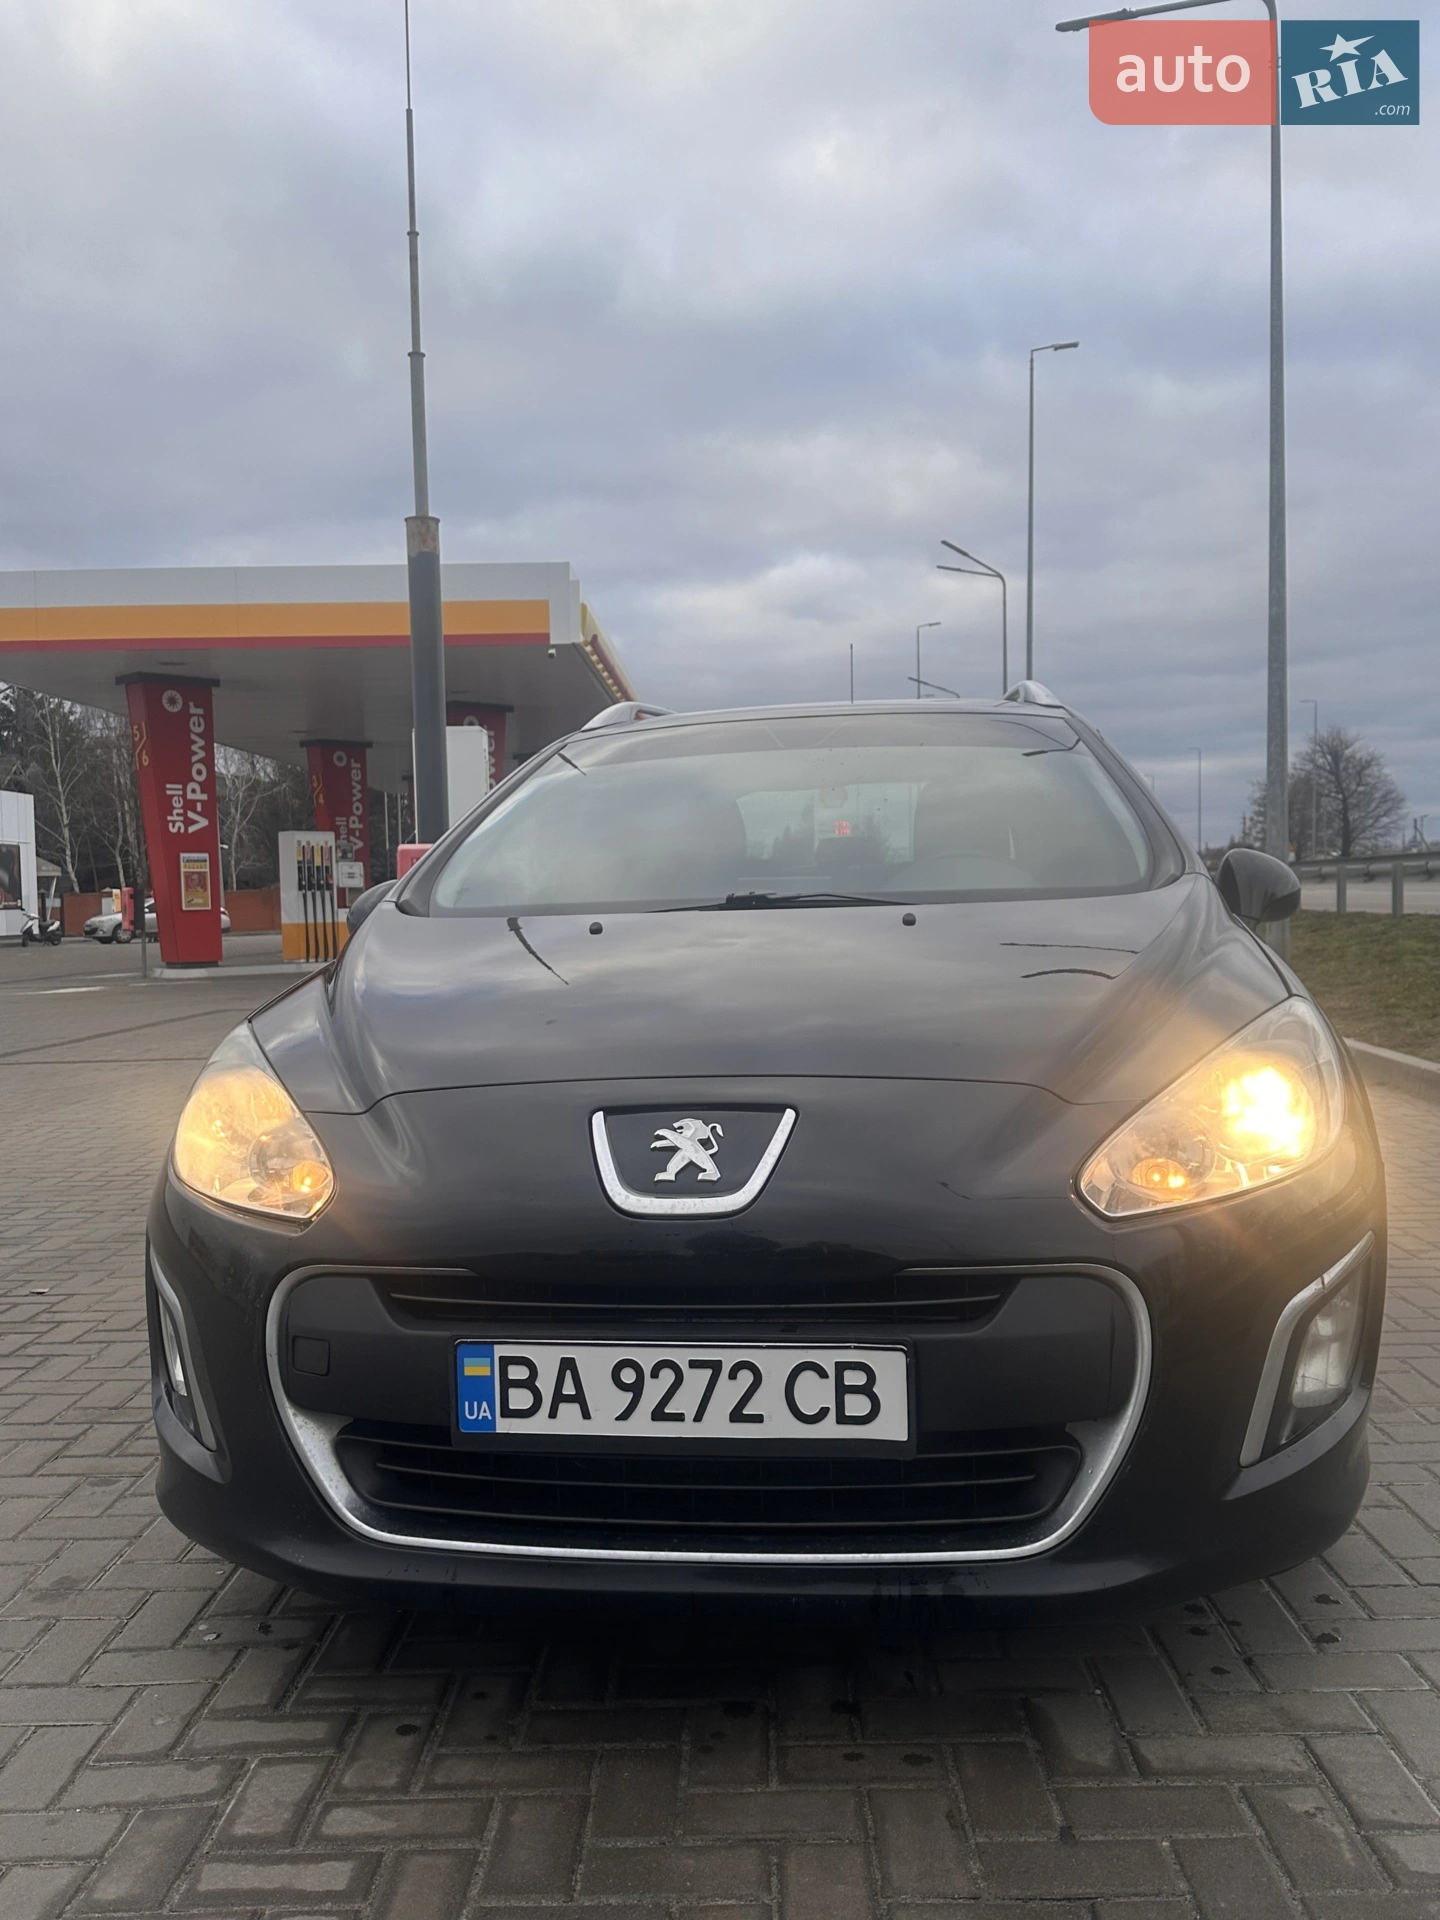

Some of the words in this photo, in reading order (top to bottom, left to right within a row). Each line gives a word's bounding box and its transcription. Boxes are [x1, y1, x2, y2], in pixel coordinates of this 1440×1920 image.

[133, 725, 140, 741] 5
[142, 751, 149, 766] 6
[186, 701, 209, 834] V-Power
[166, 783, 185, 834] Shell
[349, 758, 364, 850] V-Power
[335, 816, 348, 844] hell
[498, 1355, 592, 1420] BA
[610, 1358, 765, 1424] 9272
[784, 1360, 882, 1425] CB
[464, 1401, 492, 1421] UA
